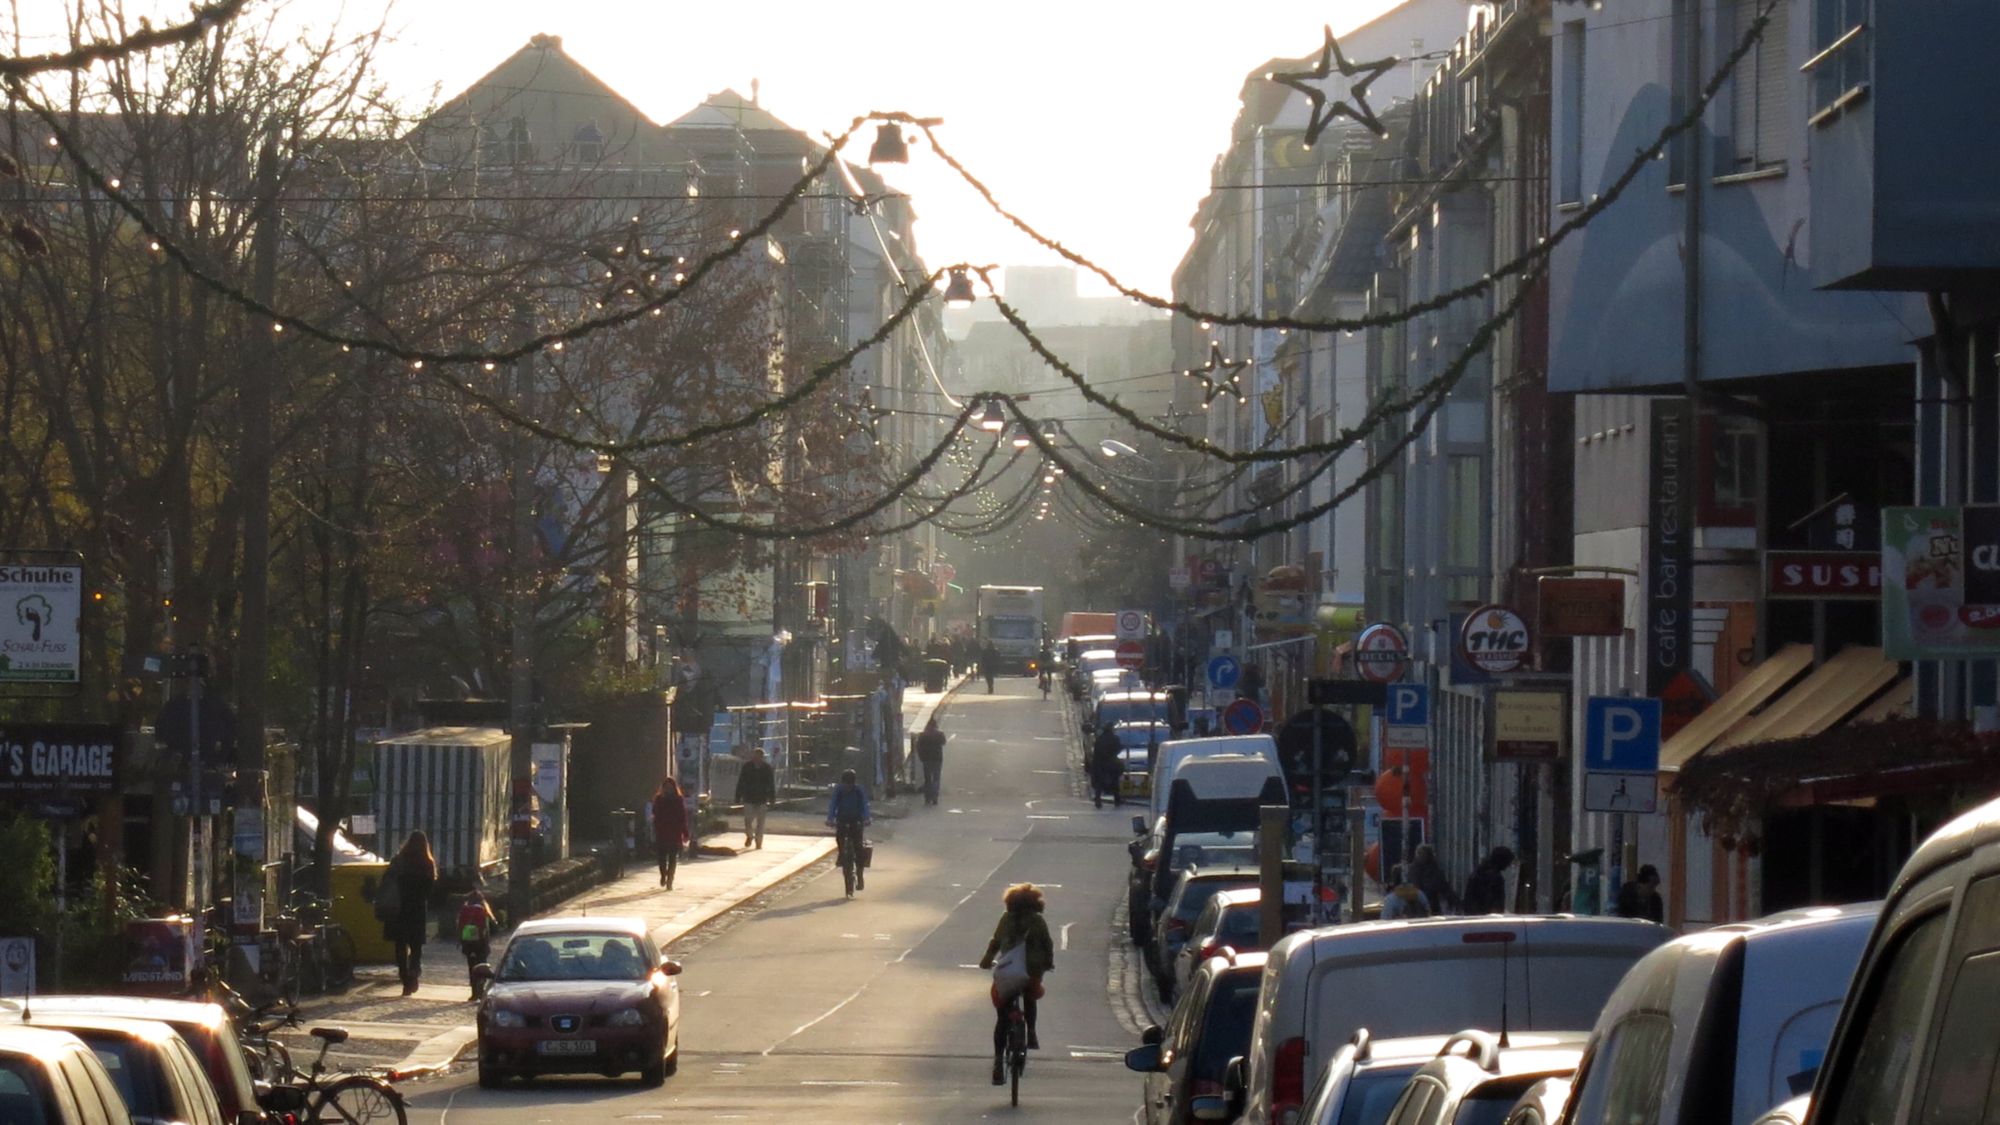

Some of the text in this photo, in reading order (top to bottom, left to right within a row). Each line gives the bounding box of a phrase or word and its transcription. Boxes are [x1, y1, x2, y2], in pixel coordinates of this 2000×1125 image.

[1655, 414, 1680, 668] cafe bar restaurant
[0, 567, 73, 583] Schuhe
[1471, 630, 1525, 651] THC
[1396, 689, 1419, 720] P
[1602, 706, 1642, 761] P
[31, 740, 114, 776] GARAGE
